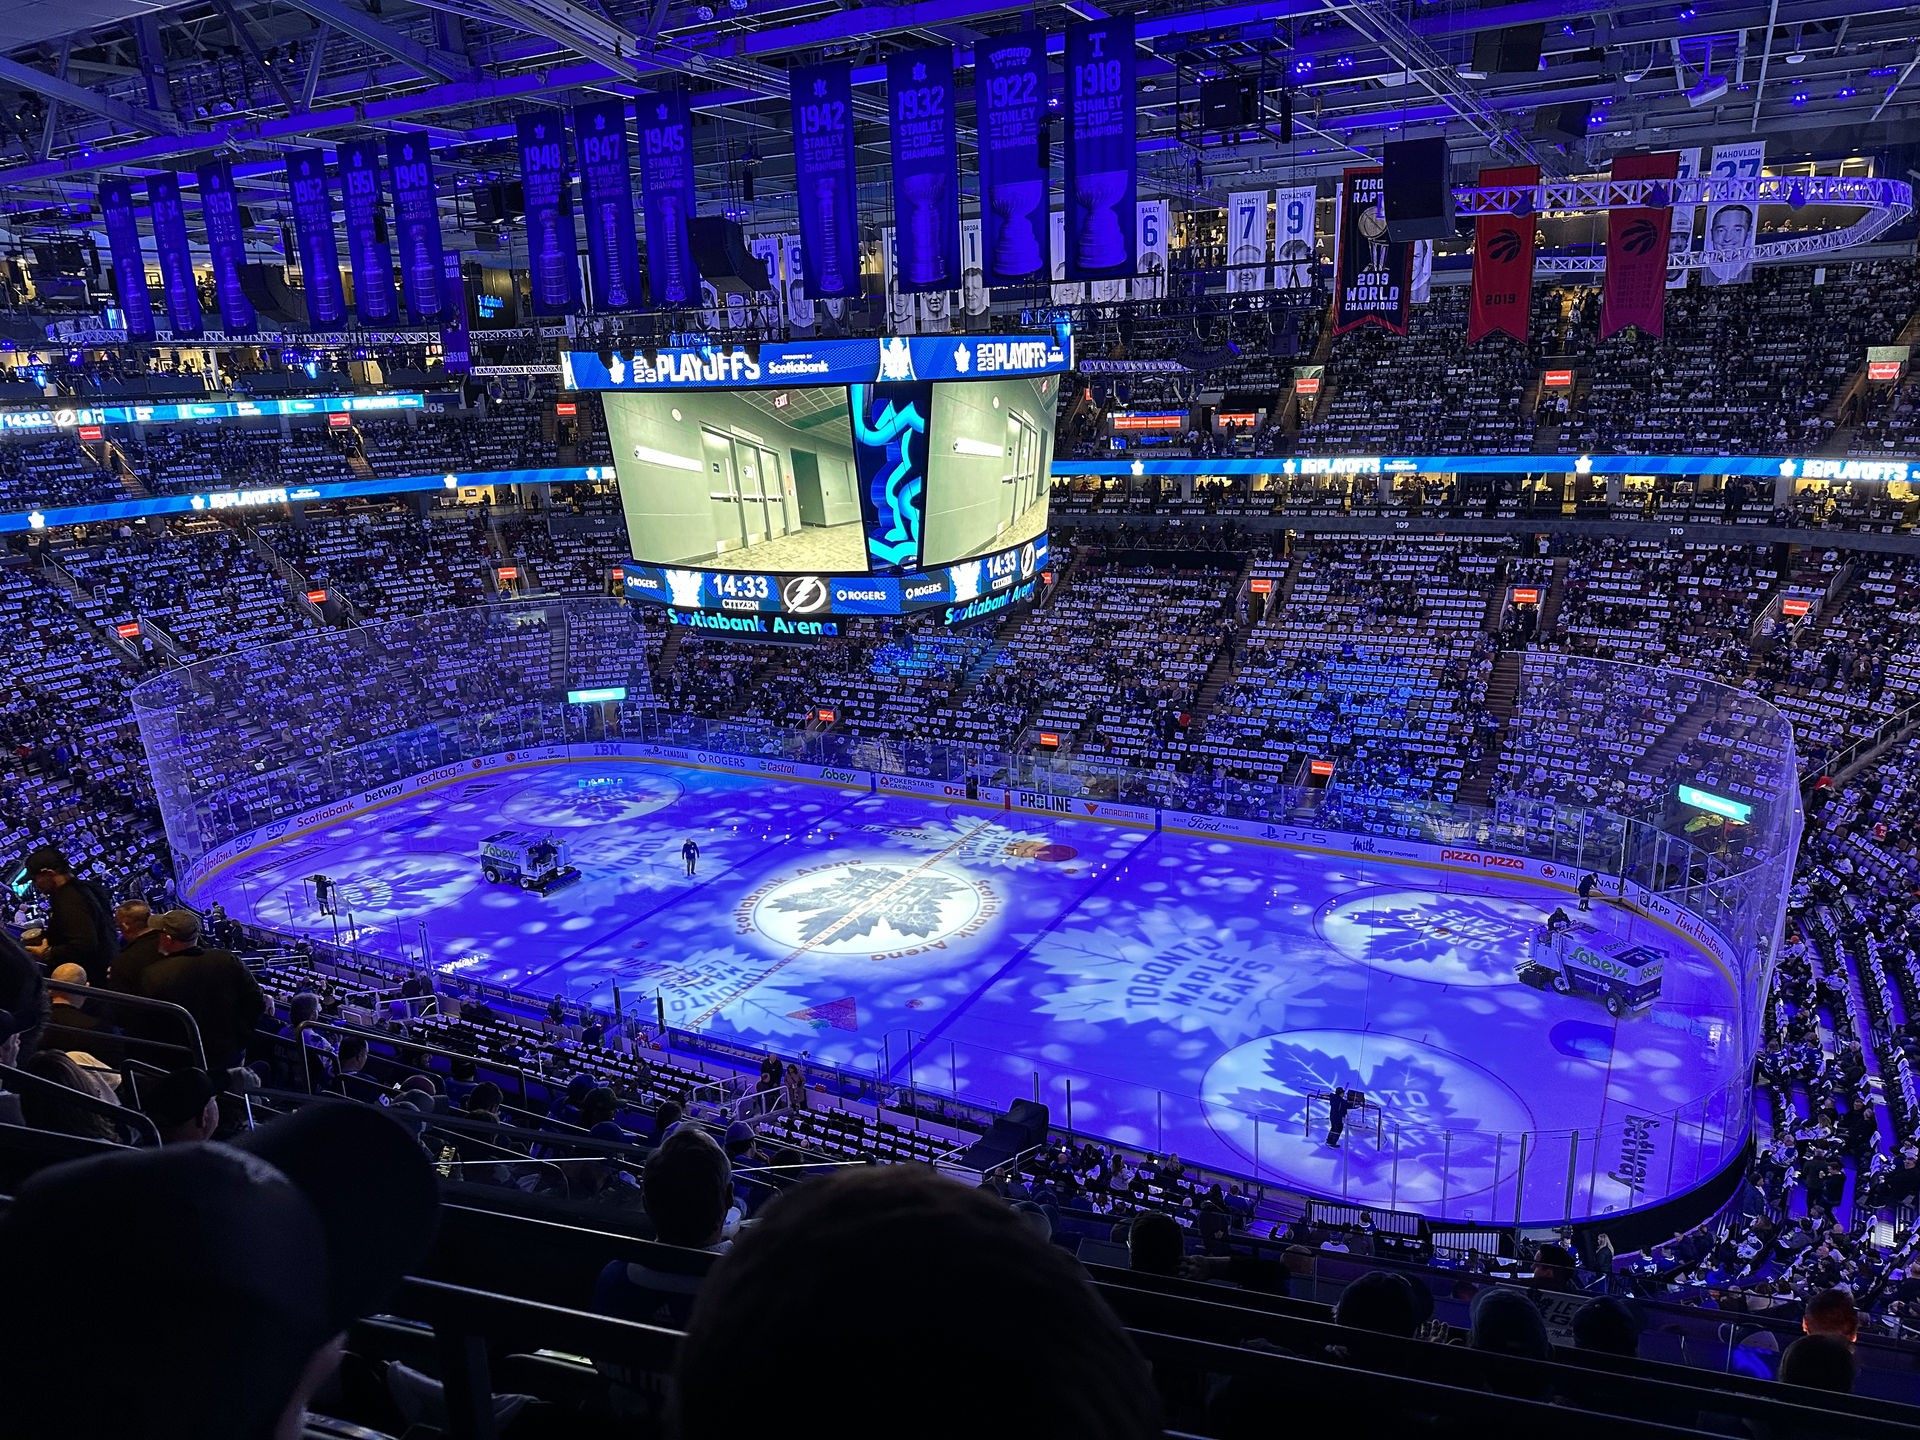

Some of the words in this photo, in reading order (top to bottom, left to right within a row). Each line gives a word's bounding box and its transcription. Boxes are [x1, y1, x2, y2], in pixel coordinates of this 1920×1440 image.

[1075, 60, 1121, 97] 1918
[986, 72, 1038, 109] 1922
[898, 85, 944, 121] 1932
[1074, 94, 1123, 113] STANLEY
[801, 101, 844, 134] 1942
[989, 107, 1036, 125] STANLEY
[1087, 112, 1109, 125] CUP
[901, 119, 943, 136] STANLEY
[1002, 123, 1023, 136] CUP
[1074, 123, 1123, 140] CHAMPIONS
[644, 124, 684, 154] 1945
[804, 134, 843, 150] STANLEY
[913, 135, 932, 147] CUP
[990, 134, 1037, 150] CHAMPIONS
[584, 134, 620, 163] 1947
[815, 150, 833, 161] CUP
[901, 146, 945, 160] CHAMPIONS
[1716, 148, 1761, 160] MAHOVLICH
[525, 144, 560, 172] 1948
[649, 156, 682, 168] STANLEY
[804, 160, 846, 173] CHAMPIONS
[394, 163, 428, 189] 1949
[659, 169, 675, 179] CUP
[1354, 178, 1384, 191] TORO
[1239, 206, 1256, 239] 7
[1286, 200, 1304, 234] 9
[1142, 215, 1158, 247] 6
[969, 232, 976, 263] 1
[1357, 273, 1389, 287] 2019
[1346, 286, 1399, 301] WORLD
[1485, 293, 1516, 306] 2019
[1345, 302, 1398, 311] CHAMPIONS
[977, 344, 994, 358] 20
[995, 342, 1046, 370] PLAYOFFS
[656, 352, 761, 382] PLAYOFFS
[768, 360, 829, 374] Scotiabank
[977, 358, 995, 372] 23
[633, 369, 657, 383] 23
[1823, 460, 1908, 481] PLAYOFFS
[1395, 521, 1410, 530] 109
[1669, 526, 1684, 536] 110
[986, 551, 1017, 578] 14:33
[634, 577, 658, 589] ROGERS
[713, 574, 769, 599] 14:33
[913, 583, 942, 598] ROGERS
[847, 590, 887, 601] ROGERS
[721, 600, 760, 611] CITIZEN
[944, 592, 1011, 626] Scotiabank
[667, 608, 768, 633] Scotiabank
[773, 617, 839, 636] Arena
[517, 751, 530, 760] LG
[594, 744, 622, 756] IBM
[663, 749, 689, 760] CANADIAN
[484, 757, 496, 766] LG
[708, 754, 745, 768] ROGERS
[767, 762, 796, 775] Castrol
[820, 767, 856, 784] Sobeys
[889, 777, 935, 789] POKERSTARS
[364, 783, 405, 804] betway
[889, 783, 913, 791] CASINO
[1020, 792, 1072, 813] PROLINE
[297, 800, 355, 828] Scotiabank
[1101, 807, 1134, 818] CANADIAN
[1135, 811, 1150, 820] TIRE
[266, 823, 287, 838] SAP
[1187, 815, 1222, 832] Ford
[235, 836, 253, 851] SAP
[1283, 829, 1327, 845] PS5
[482, 843, 518, 860] Sobeys
[1351, 836, 1376, 854] milk
[1377, 848, 1394, 857] every
[1394, 850, 1419, 859] moment
[204, 849, 233, 872] Hortons
[1440, 849, 1481, 864] pizza
[1483, 855, 1525, 870] pizza
[1558, 870, 1576, 881] AIR
[735, 877, 787, 936] Scotiabank
[796, 858, 862, 877] Arena
[959, 879, 1002, 939] Scotiabank
[1675, 909, 1694, 935] Tim
[1693, 923, 1725, 960] Hortons
[870, 940, 949, 961] Arena
[1568, 947, 1629, 978] Sobeys
[1125, 935, 1223, 1008] TORONTO
[1163, 951, 1240, 1007] MAPLE
[1639, 964, 1664, 980] Sobeys
[1198, 959, 1275, 1016] LEAFS
